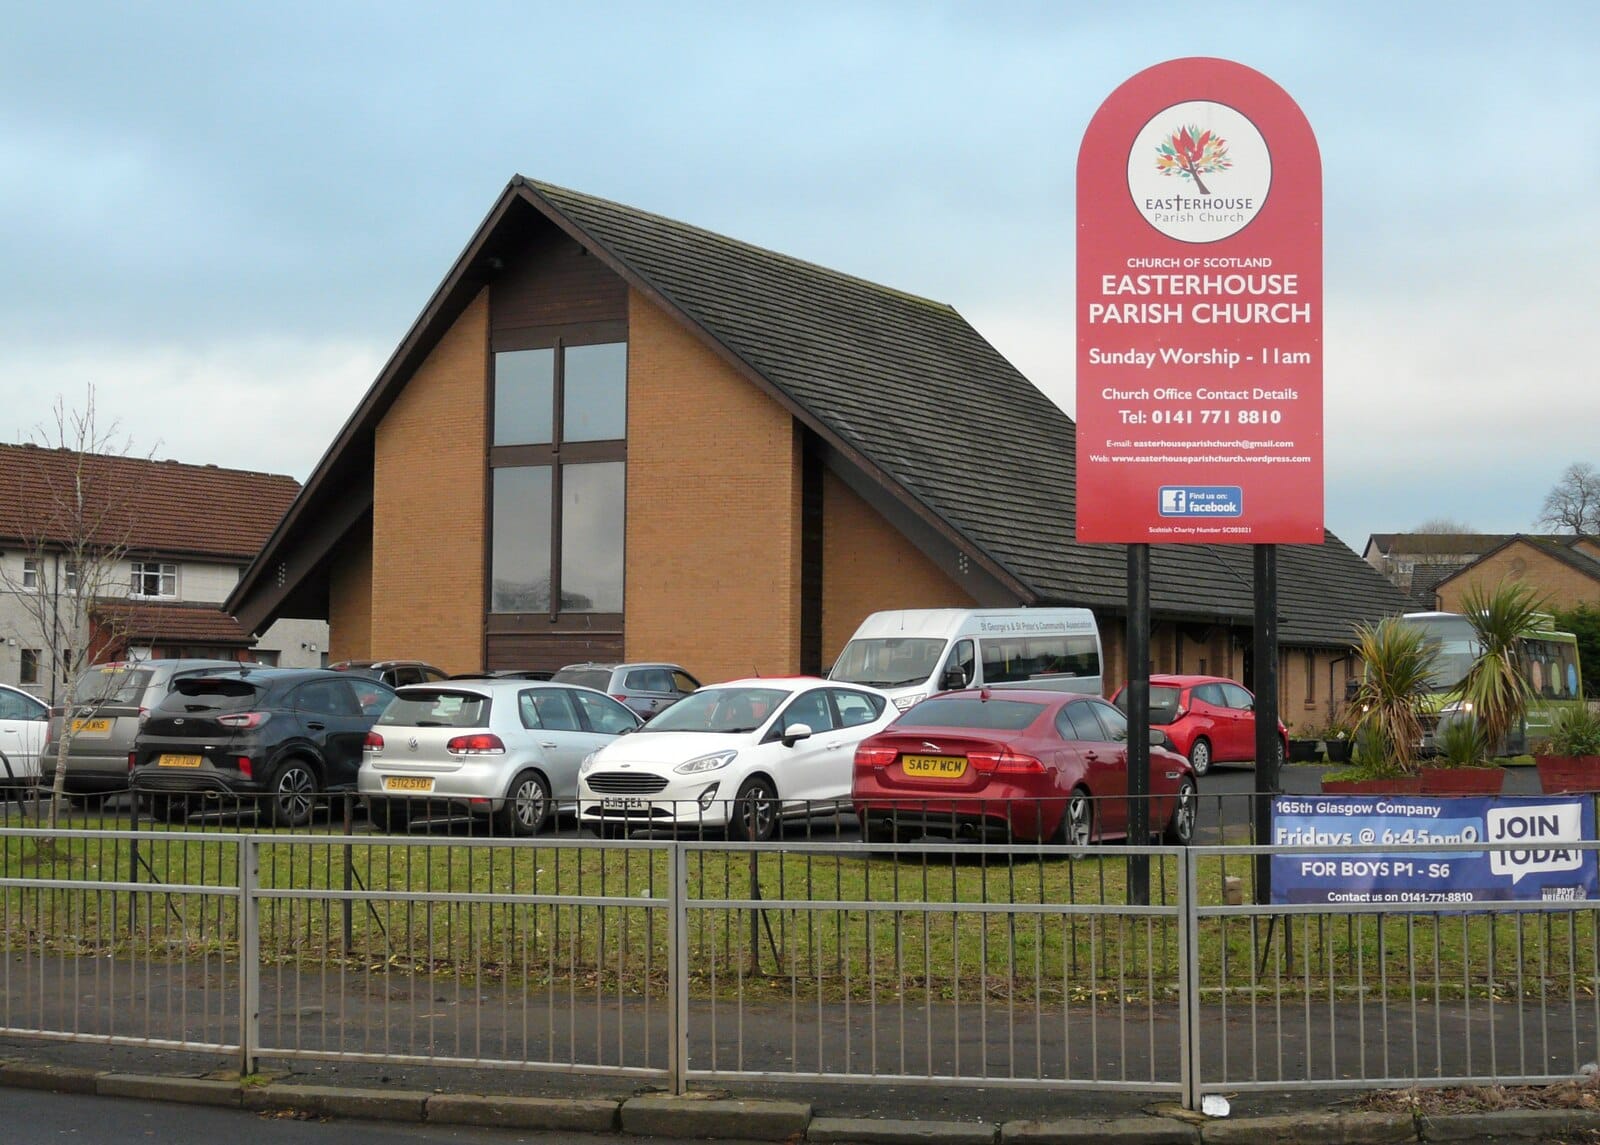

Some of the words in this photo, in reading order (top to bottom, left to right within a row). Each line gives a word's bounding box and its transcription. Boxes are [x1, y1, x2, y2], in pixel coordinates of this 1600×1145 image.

[1145, 194, 1253, 212] EASTERHOUSE
[1154, 212, 1194, 223] Parish
[1199, 212, 1244, 223] Church
[1127, 258, 1180, 268] CHURCH
[1183, 258, 1201, 268] OF
[1203, 258, 1272, 268] SCOTLAND
[1102, 274, 1298, 295] EASTERHOUSE
[1089, 303, 1182, 324] PARISH
[1191, 303, 1310, 324] CHURCH
[1089, 348, 1156, 369] Sunday
[1160, 348, 1240, 369] Worship
[1261, 348, 1311, 365] 11am
[1102, 388, 1149, 400] Church
[1153, 388, 1192, 400] Office
[1196, 388, 1248, 400] Contact
[1252, 388, 1298, 400] Details
[1118, 410, 1147, 424] Tel:
[1151, 410, 1192, 424] 0141
[1200, 410, 1230, 424] 771
[1237, 410, 1281, 424] 8810
[1106, 440, 1132, 448] E-mail:
[1133, 440, 1294, 450] easterhouseparishchurch@gmail.com
[1111, 455, 1311, 465] www.easterhouseparishchurch.wordpress.com
[1189, 501, 1236, 512] facebook
[1174, 527, 1195, 535] Charity
[909, 759, 937, 770] SA67
[940, 761, 961, 772] WCM
[1276, 802, 1313, 814] 165th
[1316, 802, 1373, 816] Glasgow
[1376, 802, 1441, 817] Company
[1495, 815, 1559, 839] JOIN
[1277, 826, 1353, 845] Fridays
[1359, 828, 1376, 845] @
[1301, 862, 1337, 876] FOR
[1341, 862, 1389, 876] BOYS
[1394, 862, 1413, 877] P1
[1428, 864, 1450, 878] S6
[1327, 892, 1371, 902] Contact
[1401, 892, 1473, 903] 0141-771-8810
